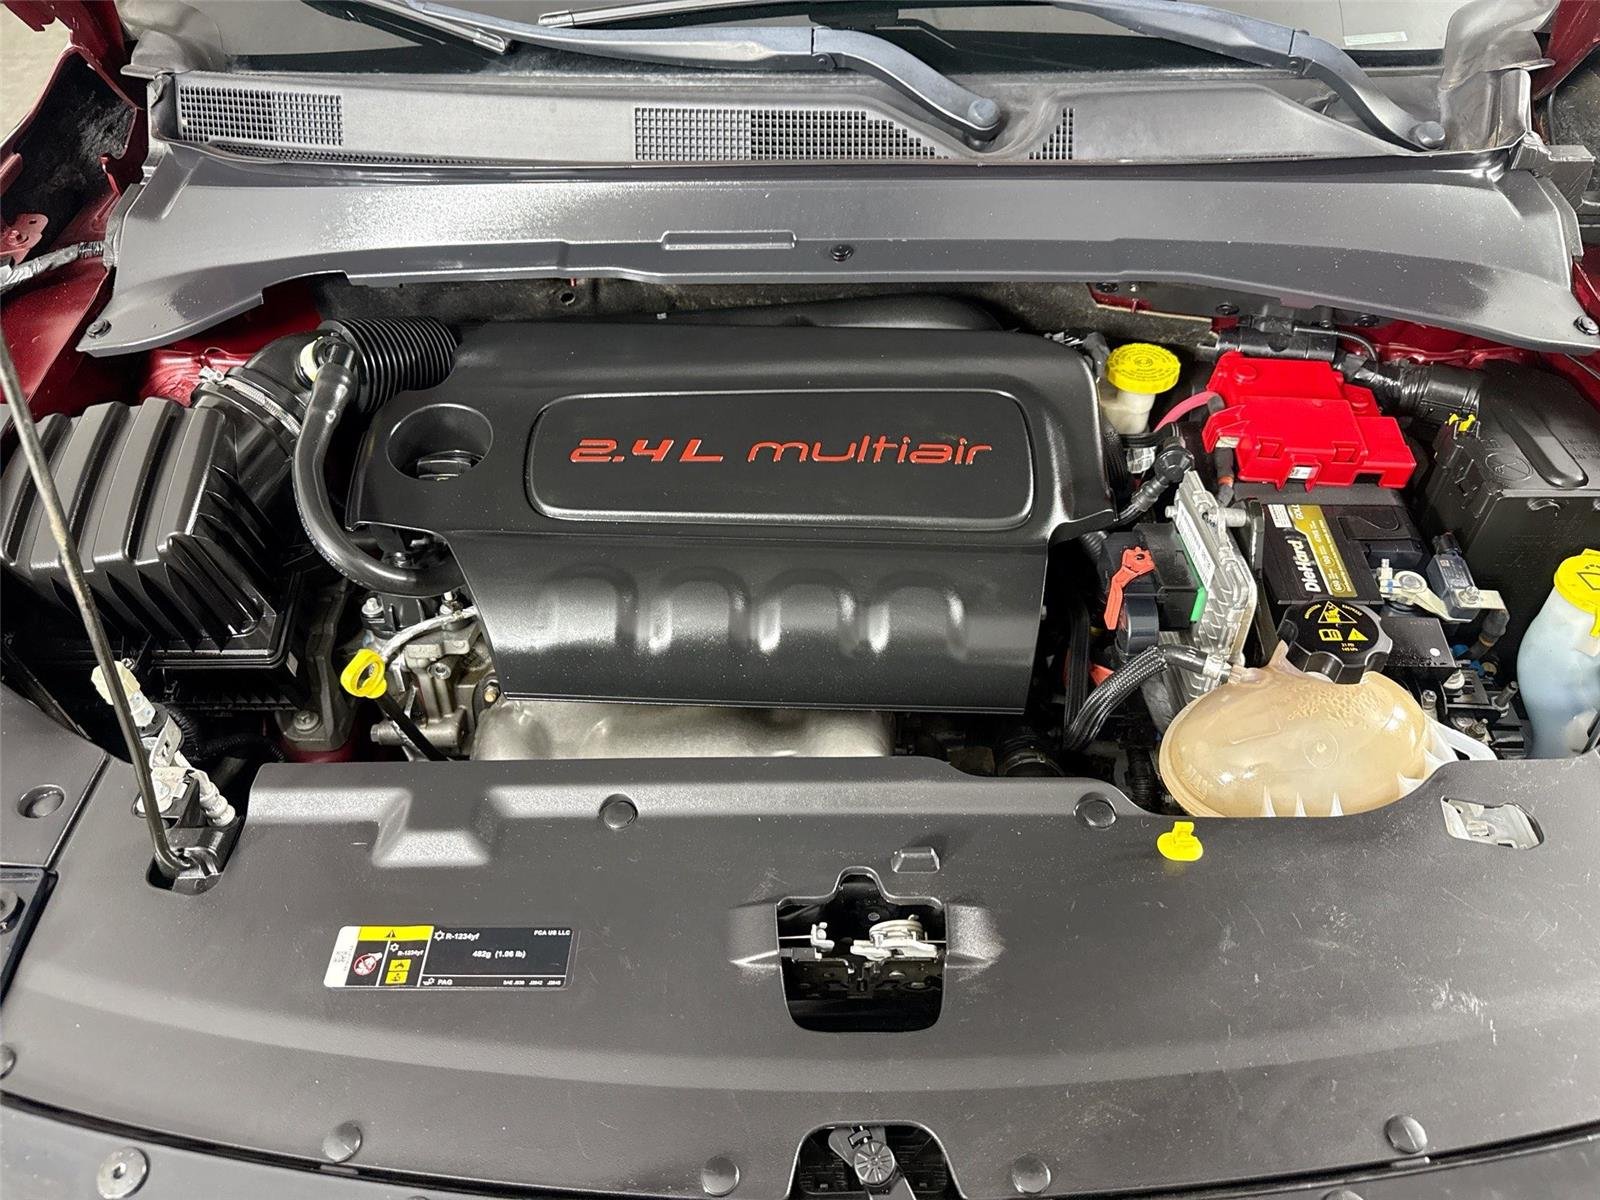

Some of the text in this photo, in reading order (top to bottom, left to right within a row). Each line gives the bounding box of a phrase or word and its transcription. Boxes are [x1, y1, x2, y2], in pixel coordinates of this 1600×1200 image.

[747, 434, 993, 466] multiair
[1287, 539, 1322, 592] DieHard
[445, 932, 480, 941] R-1234yf
[515, 950, 527, 959] lb)
